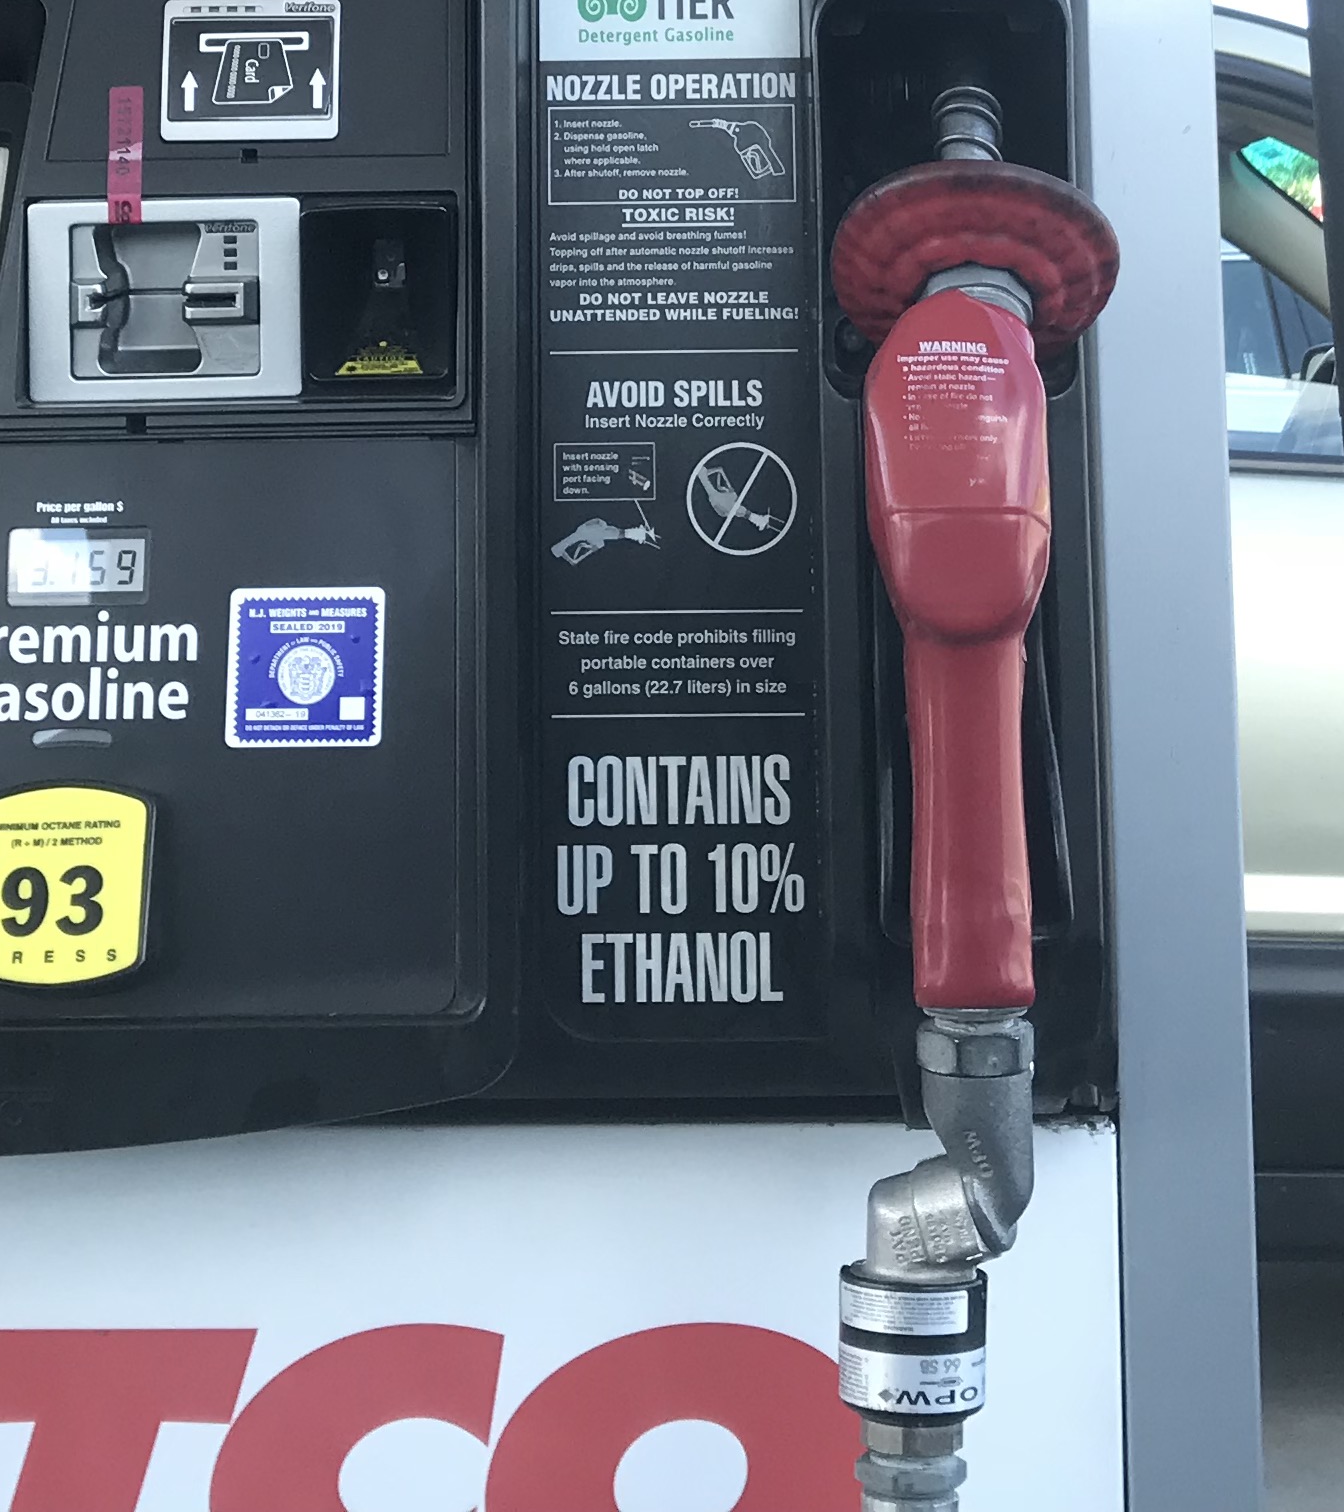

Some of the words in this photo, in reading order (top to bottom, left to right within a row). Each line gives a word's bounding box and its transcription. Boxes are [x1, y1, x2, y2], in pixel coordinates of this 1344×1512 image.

[579, 29, 657, 46] Detergent
[665, 26, 733, 42] Gasoline
[547, 75, 641, 101] NOZZLE
[651, 72, 795, 99] OPERATION
[619, 189, 638, 200] DO
[643, 189, 671, 200] NOT
[676, 188, 704, 199] TOP
[708, 188, 738, 198] OFF!
[622, 208, 679, 221] TOXIC
[685, 207, 734, 221] RISK!
[587, 380, 664, 408] AVOID
[674, 379, 762, 407] SPILLS
[586, 414, 630, 428] Insert
[636, 413, 687, 428] Nozzle
[692, 413, 764, 430] Correctly
[37, 501, 62, 513] Price
[64, 503, 81, 514] per
[84, 501, 114, 513] gallon
[117, 501, 123, 512] $
[273, 623, 313, 631] SEALED
[319, 623, 342, 631] 2019
[559, 631, 599, 645] State
[604, 630, 629, 644] fire
[634, 630, 673, 644] code
[678, 629, 747, 647] prohibits
[752, 629, 795, 647] filling
[568, 755, 790, 826] CONTAINS
[558, 845, 612, 915] UP
[631, 843, 687, 914] TO
[708, 843, 804, 913] 10%
[2, 865, 103, 937] 93
[582, 932, 783, 1002] ETHANOL
[896, 1387, 978, 1406] OPW
